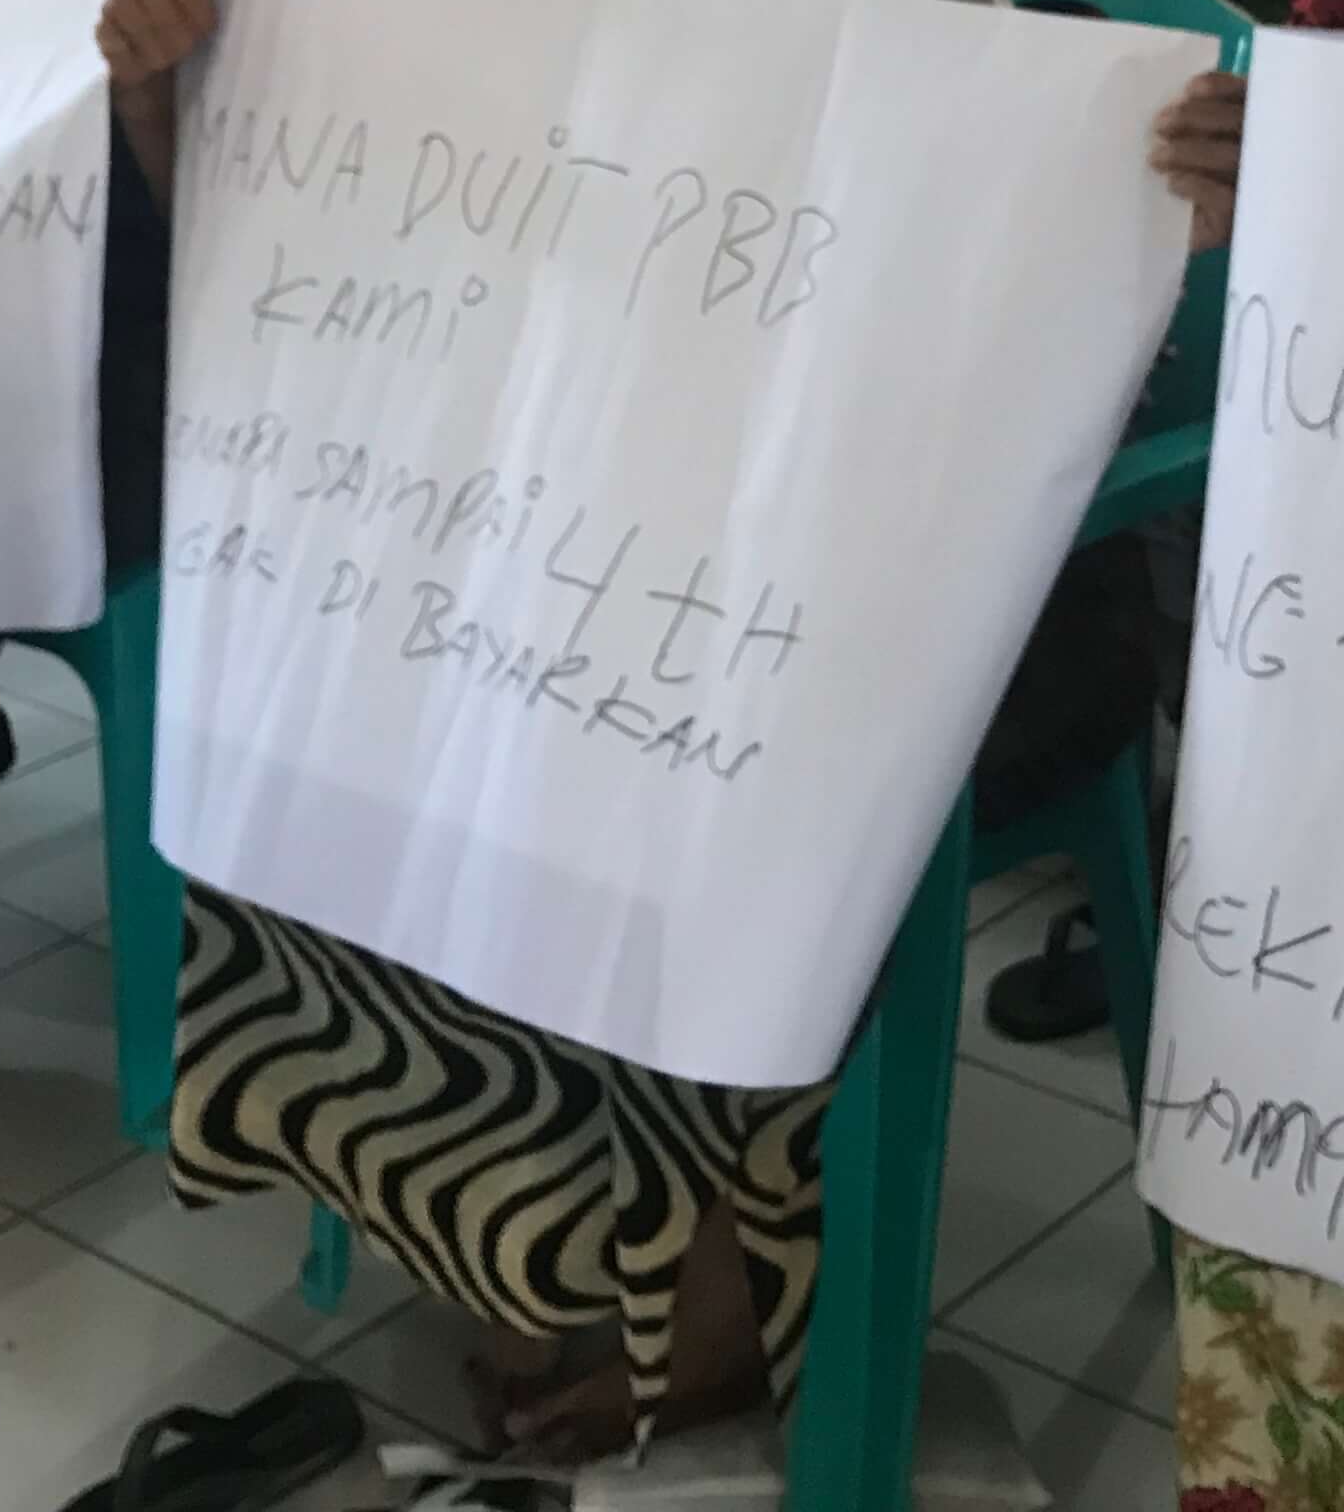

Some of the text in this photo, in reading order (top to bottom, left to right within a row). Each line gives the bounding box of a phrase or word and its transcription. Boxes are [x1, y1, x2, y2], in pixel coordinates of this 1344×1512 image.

[623, 166, 841, 329] PBB
[542, 504, 642, 660] 4
[317, 558, 382, 623] DI
[399, 578, 764, 781] BAYARKAN
